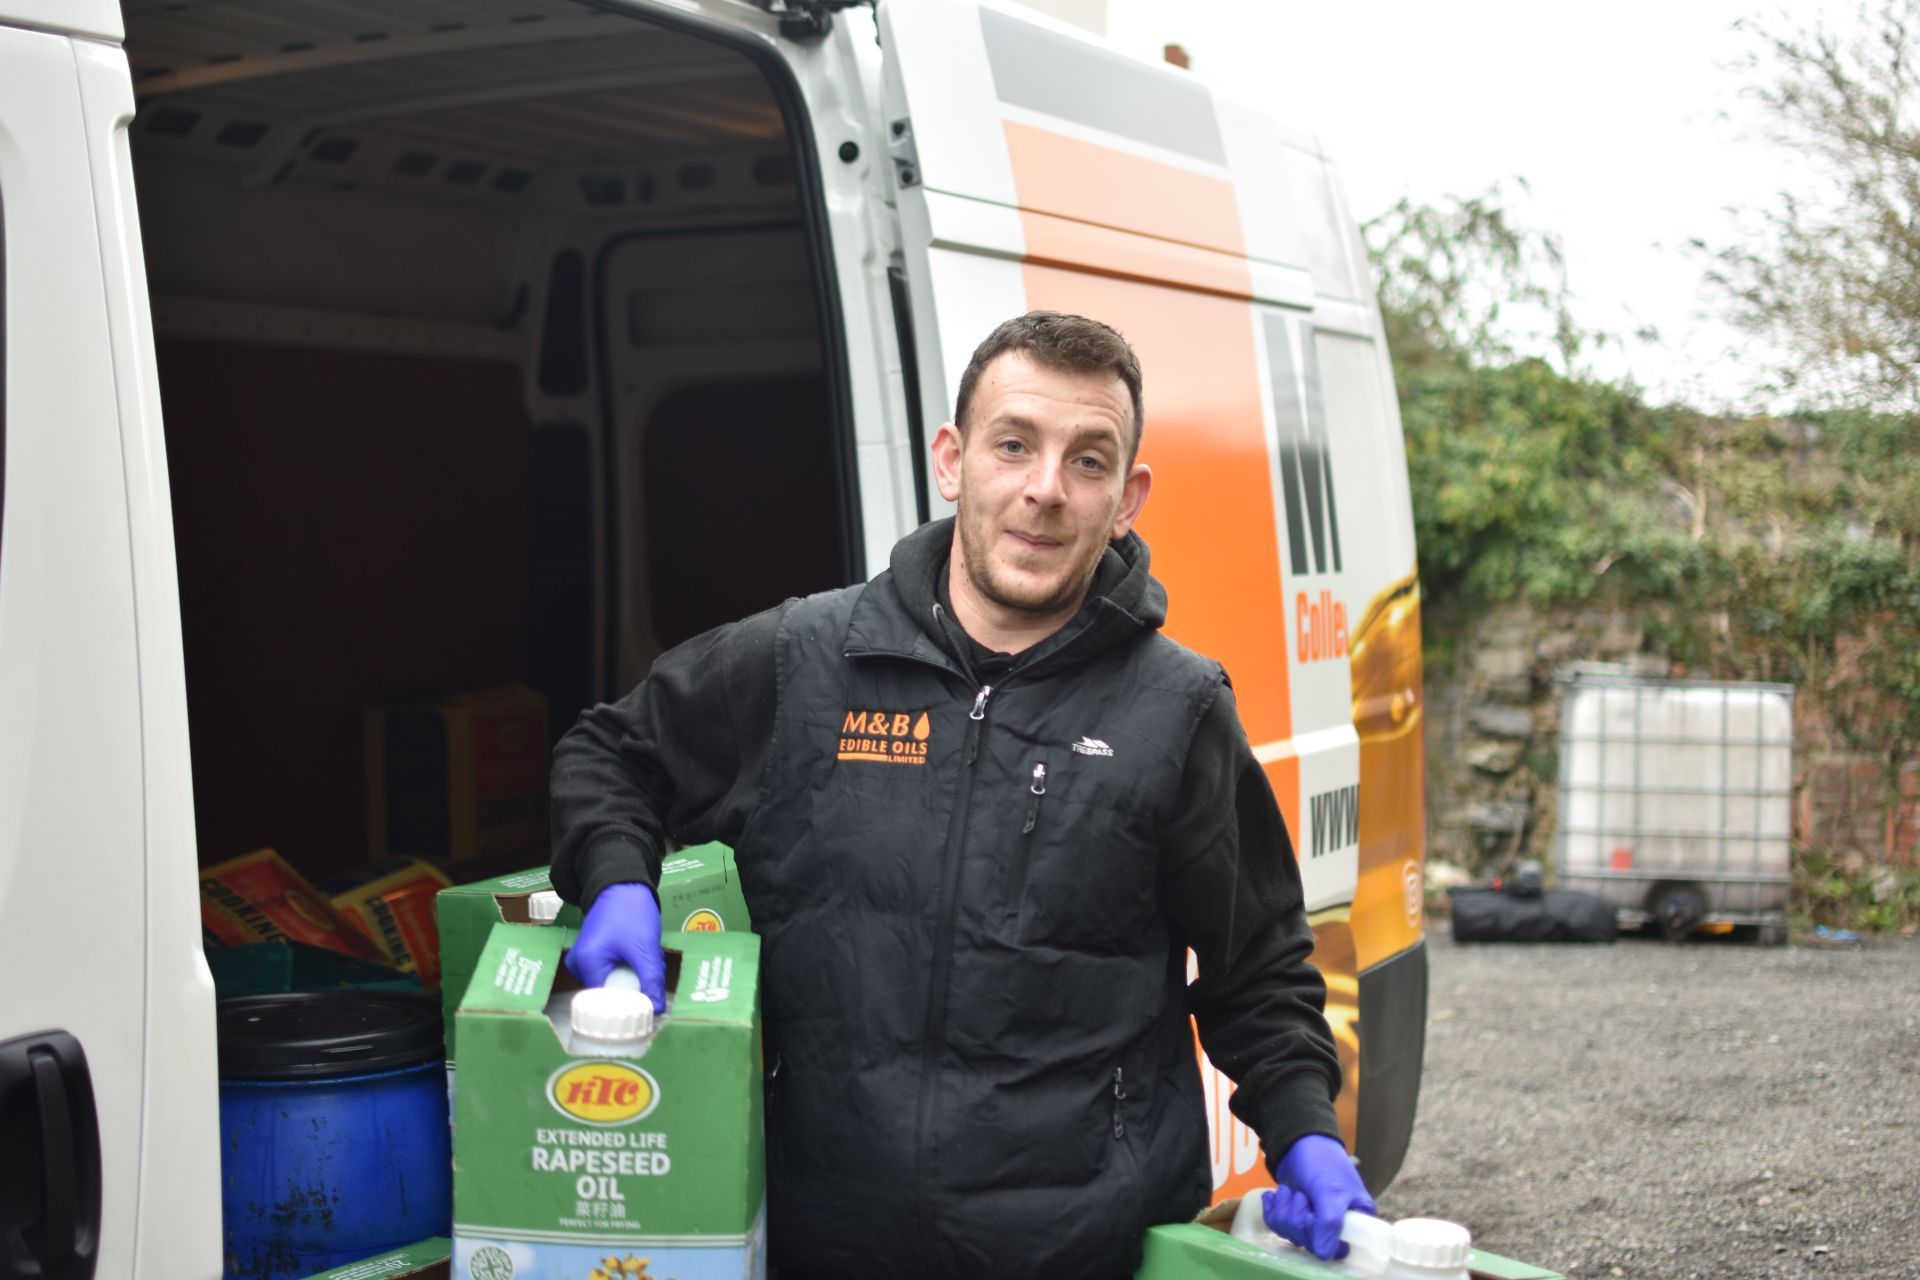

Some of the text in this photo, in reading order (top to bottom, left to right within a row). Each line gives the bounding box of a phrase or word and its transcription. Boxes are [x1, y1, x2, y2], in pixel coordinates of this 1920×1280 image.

[842, 711, 910, 736] M&B
[839, 738, 928, 755] EDIBLE OILS
[1072, 743, 1114, 757] TRESPASS
[887, 755, 926, 764] LIMITED
[536, 1128, 668, 1149] EXTENDED LIFE
[531, 1147, 671, 1176] RAPESEED
[576, 1175, 625, 1200] OIL
